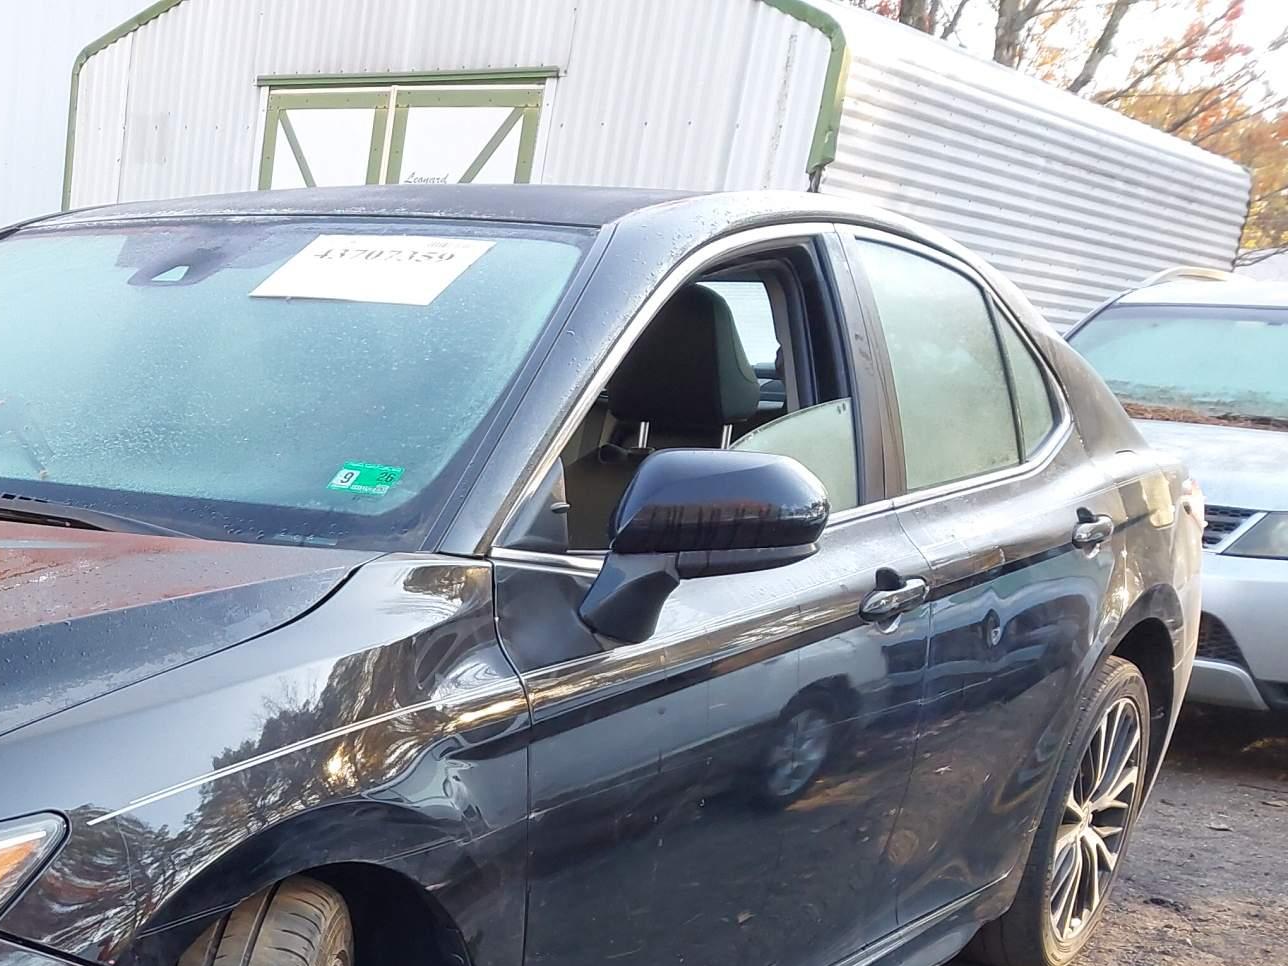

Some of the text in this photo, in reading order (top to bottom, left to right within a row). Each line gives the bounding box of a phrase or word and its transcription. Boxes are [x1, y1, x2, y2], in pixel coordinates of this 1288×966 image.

[314, 248, 456, 263] 43707359
[340, 471, 397, 484] 9 26
